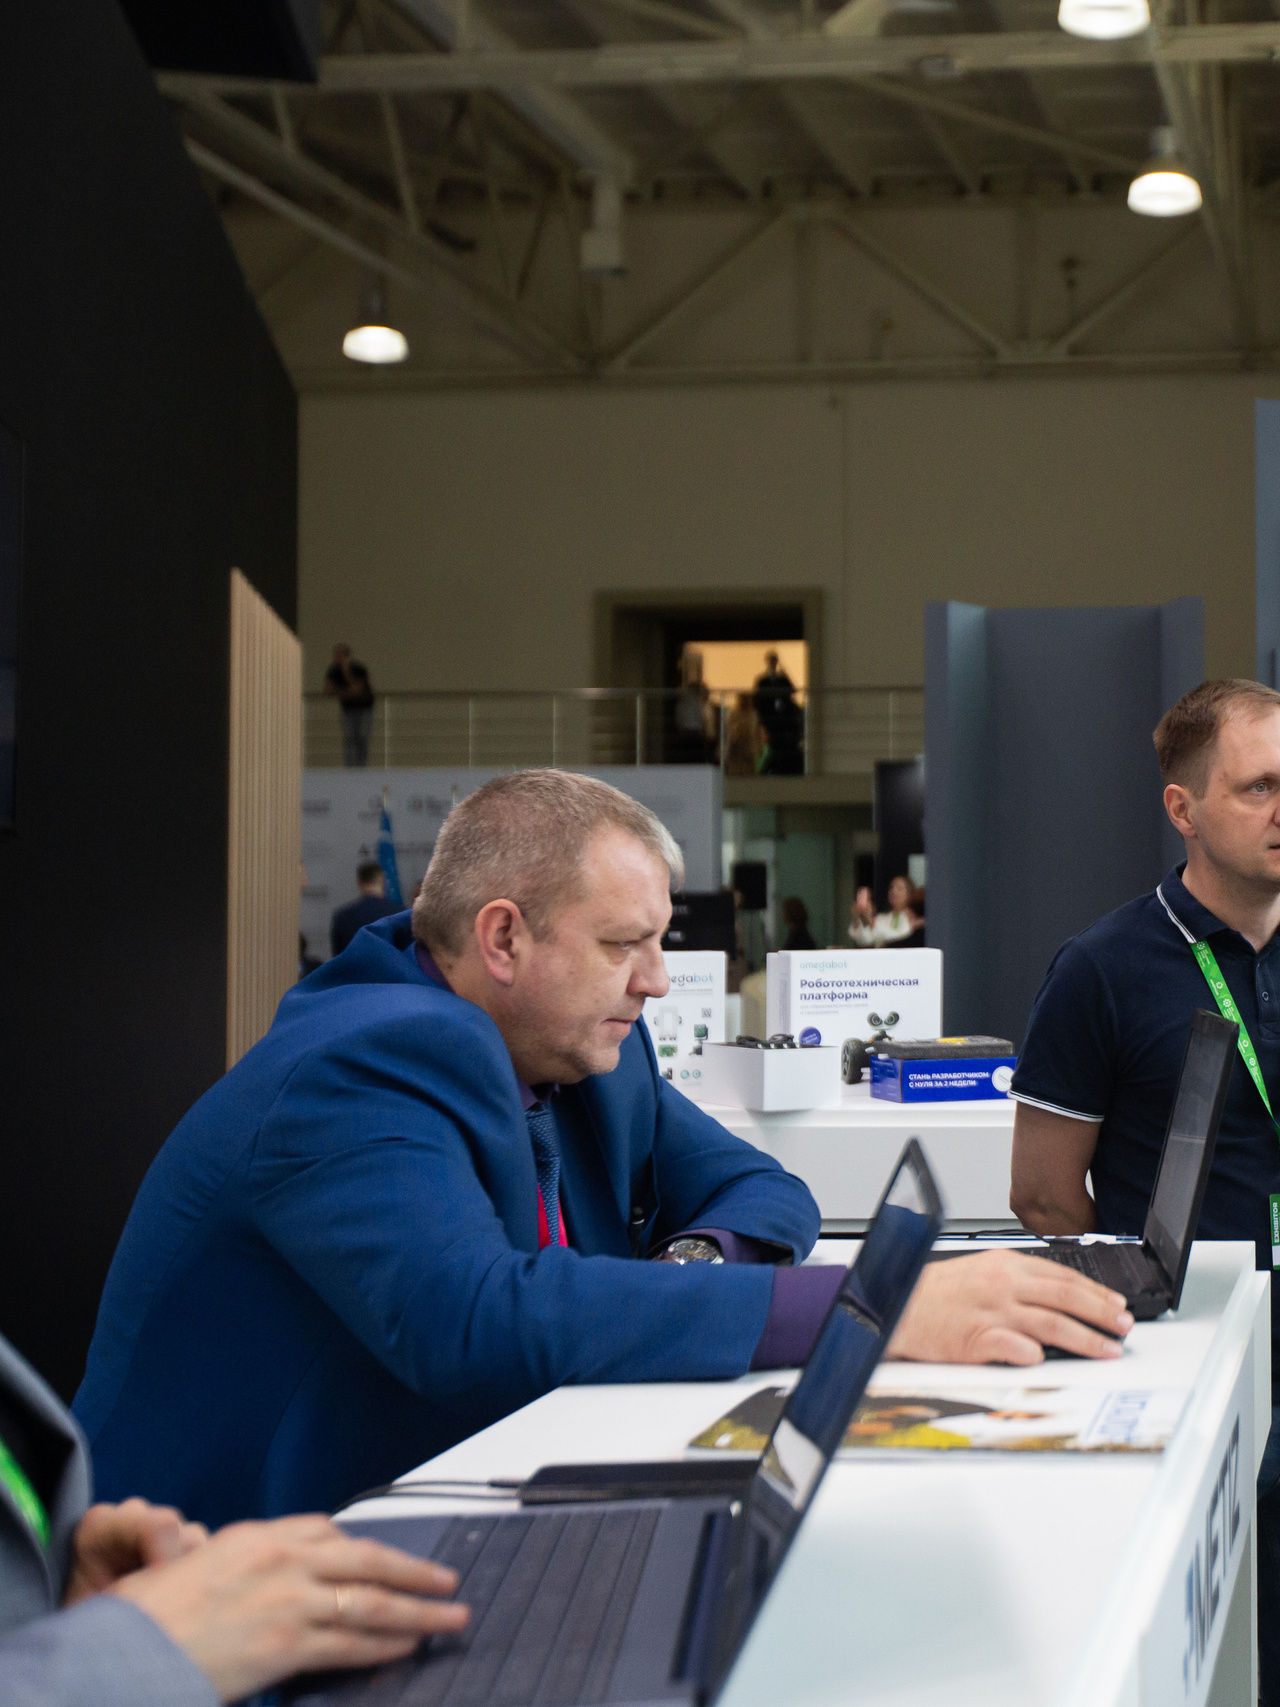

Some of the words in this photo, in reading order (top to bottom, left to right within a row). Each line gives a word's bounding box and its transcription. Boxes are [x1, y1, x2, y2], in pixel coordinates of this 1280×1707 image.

[799, 960, 848, 972] omegabot
[669, 972, 713, 987] egabot
[800, 978, 919, 988] Робототехническая
[800, 991, 868, 1001] платформа
[908, 1073, 931, 1081] СТАНЬ
[932, 1071, 990, 1080] РАЗРАБОТЧИКОМ
[1272, 1202, 1280, 1243] EXHIBITOR
